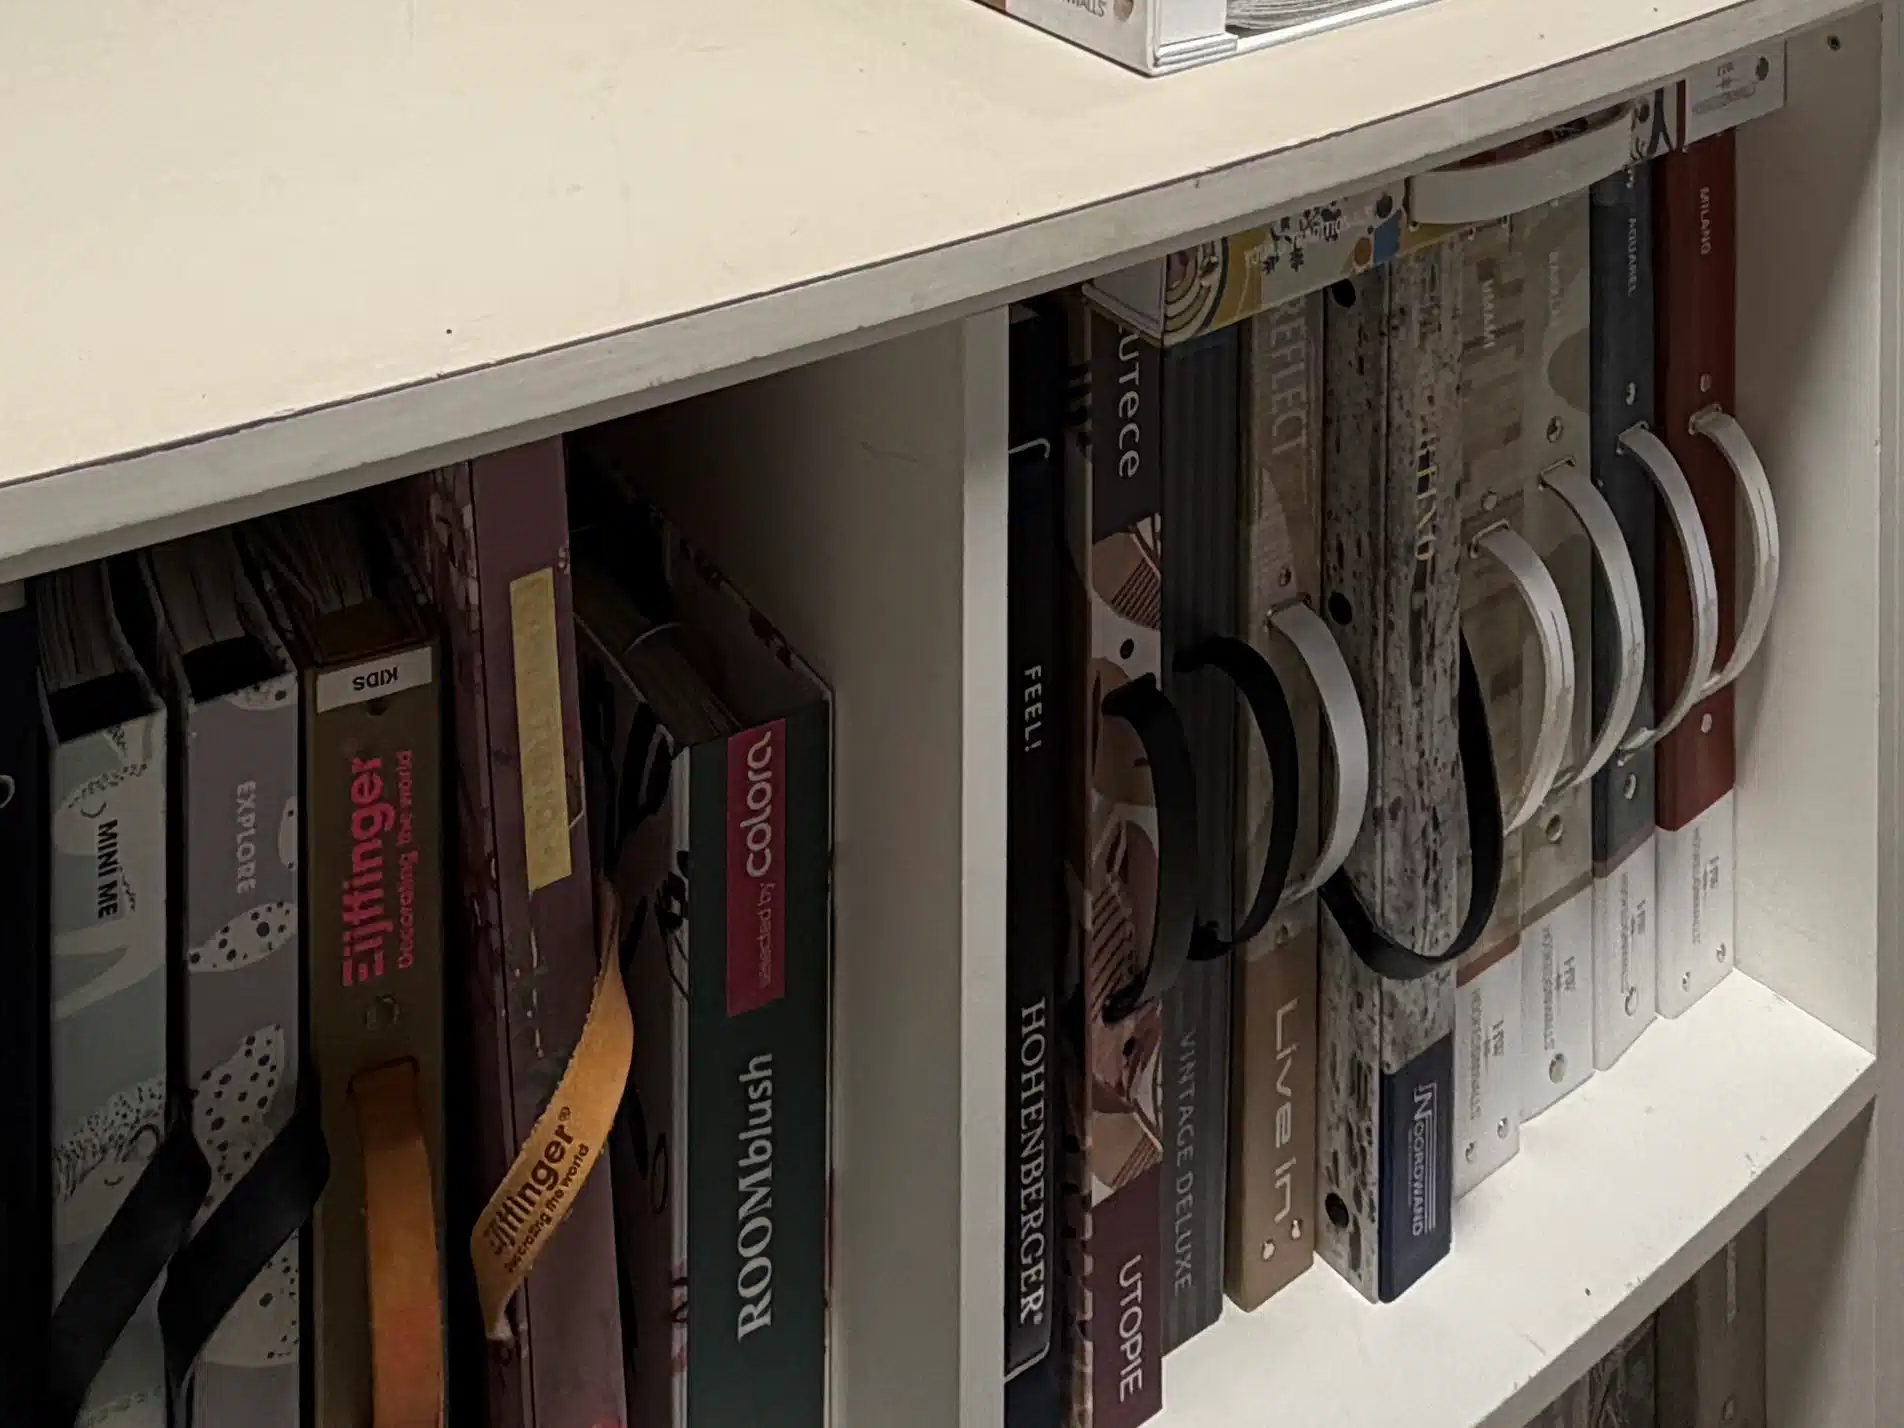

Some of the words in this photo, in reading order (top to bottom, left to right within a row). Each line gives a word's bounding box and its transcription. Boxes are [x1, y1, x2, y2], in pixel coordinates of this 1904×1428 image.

[352, 666, 399, 691] KIDS
[1023, 663, 1045, 753] FEEL!
[97, 818, 119, 881] MINI
[234, 779, 258, 895] EXPLORE
[745, 729, 772, 878] colora
[97, 883, 118, 919] ME
[342, 755, 396, 987] Eijffinger
[1176, 1029, 1197, 1168] VINTAGE
[737, 1052, 774, 1343] ROOMblush
[1174, 1175, 1195, 1297] DELUXE
[1118, 1254, 1145, 1403] UTOPIE
